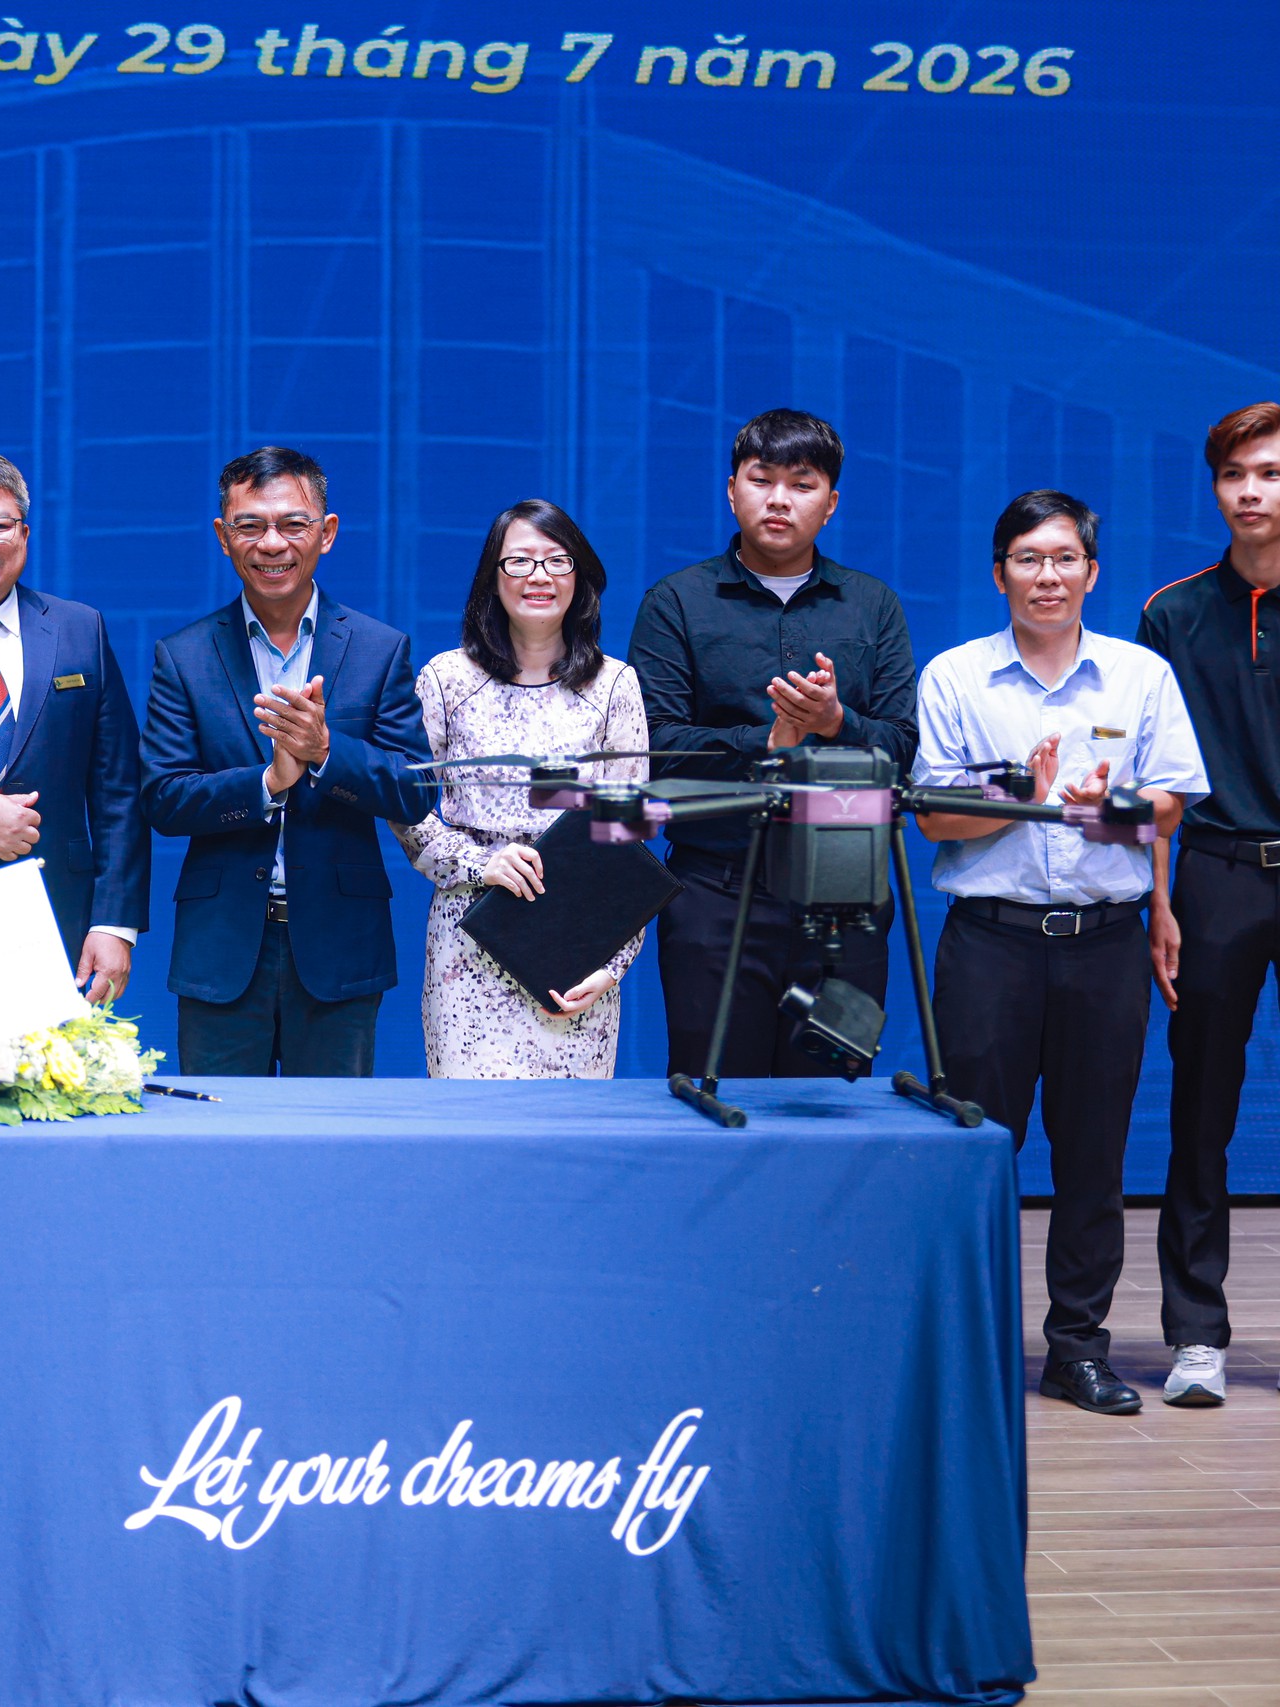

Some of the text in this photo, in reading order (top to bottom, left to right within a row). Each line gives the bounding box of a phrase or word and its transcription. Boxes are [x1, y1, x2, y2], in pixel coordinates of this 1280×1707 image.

[117, 23, 226, 76] 29
[255, 26, 529, 95] tháng
[561, 33, 614, 83] 7
[635, 34, 837, 90] năm
[863, 43, 1075, 97] 2026
[123, 1395, 711, 1556] Let your dreams fly
